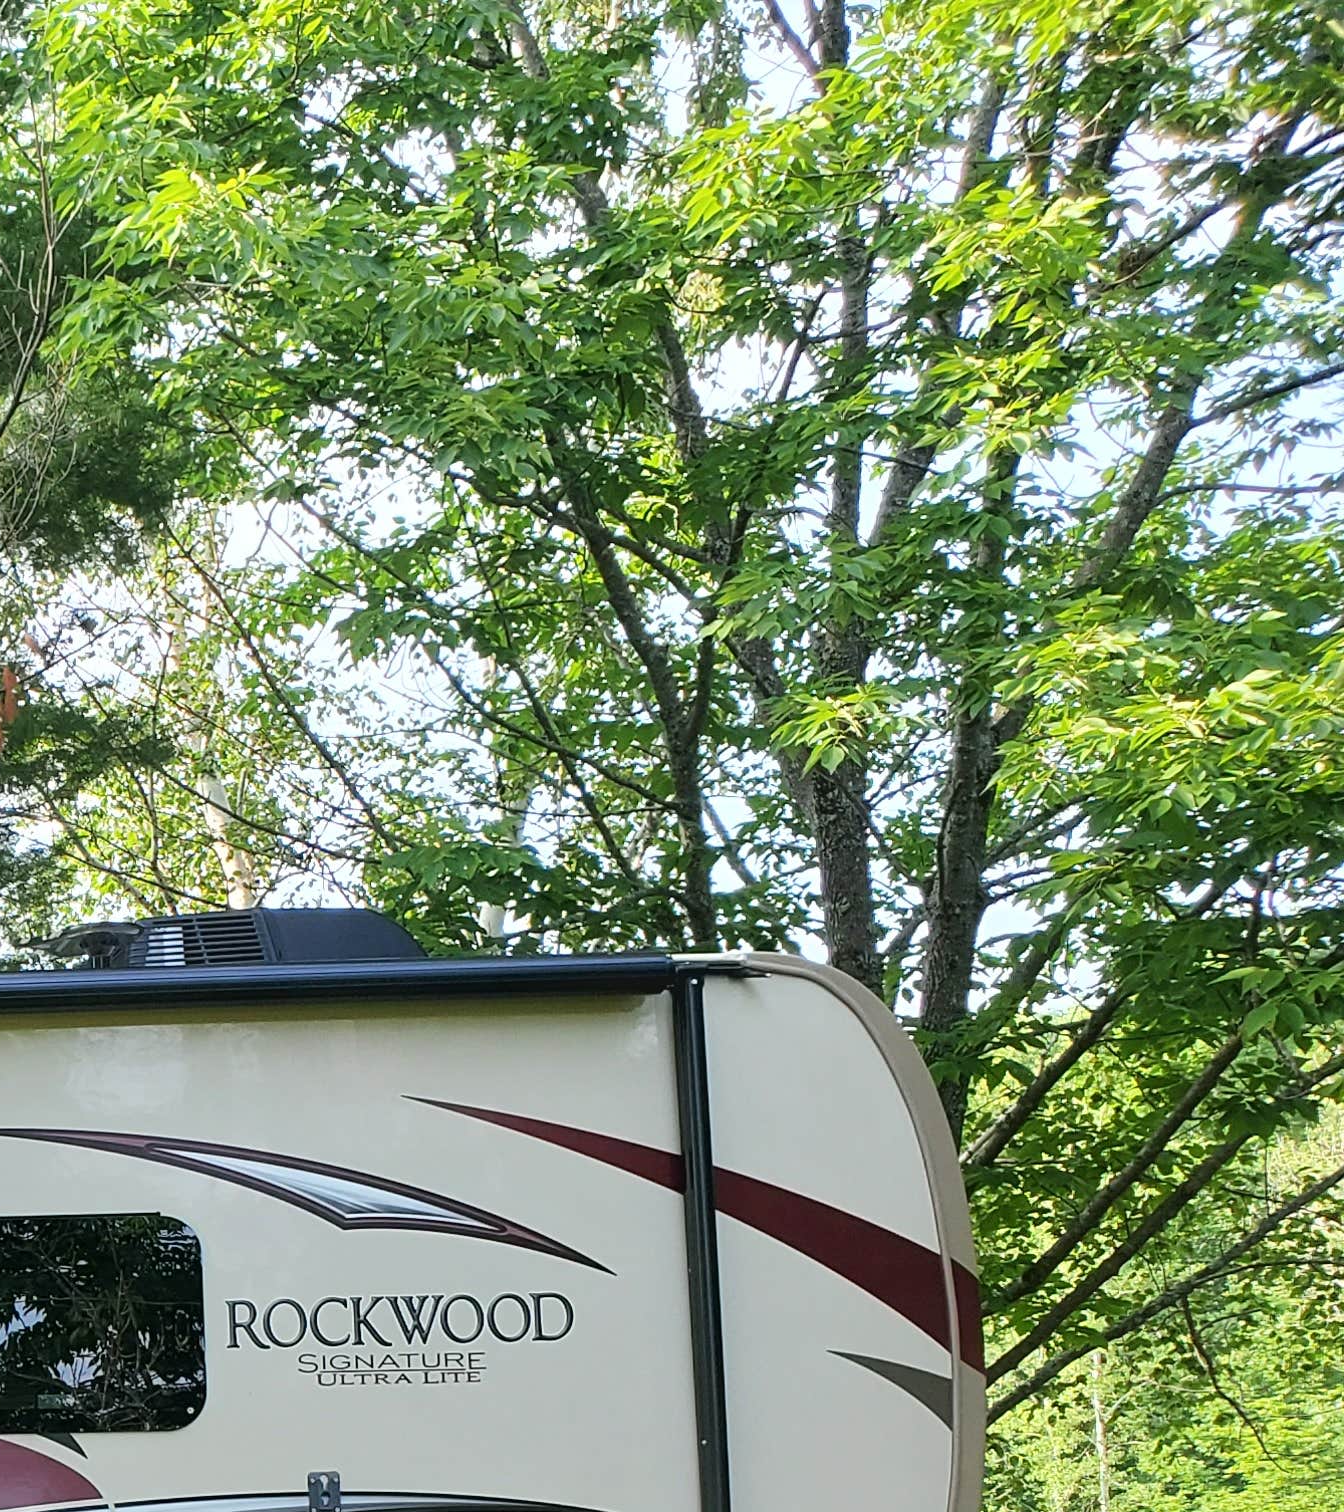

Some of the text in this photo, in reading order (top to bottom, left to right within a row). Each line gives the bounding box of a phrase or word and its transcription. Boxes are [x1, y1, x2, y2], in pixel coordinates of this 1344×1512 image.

[225, 1292, 575, 1349] ROCKWOOD
[297, 1351, 487, 1373] SIGNATURE
[317, 1371, 481, 1387] ULTRA LITE
